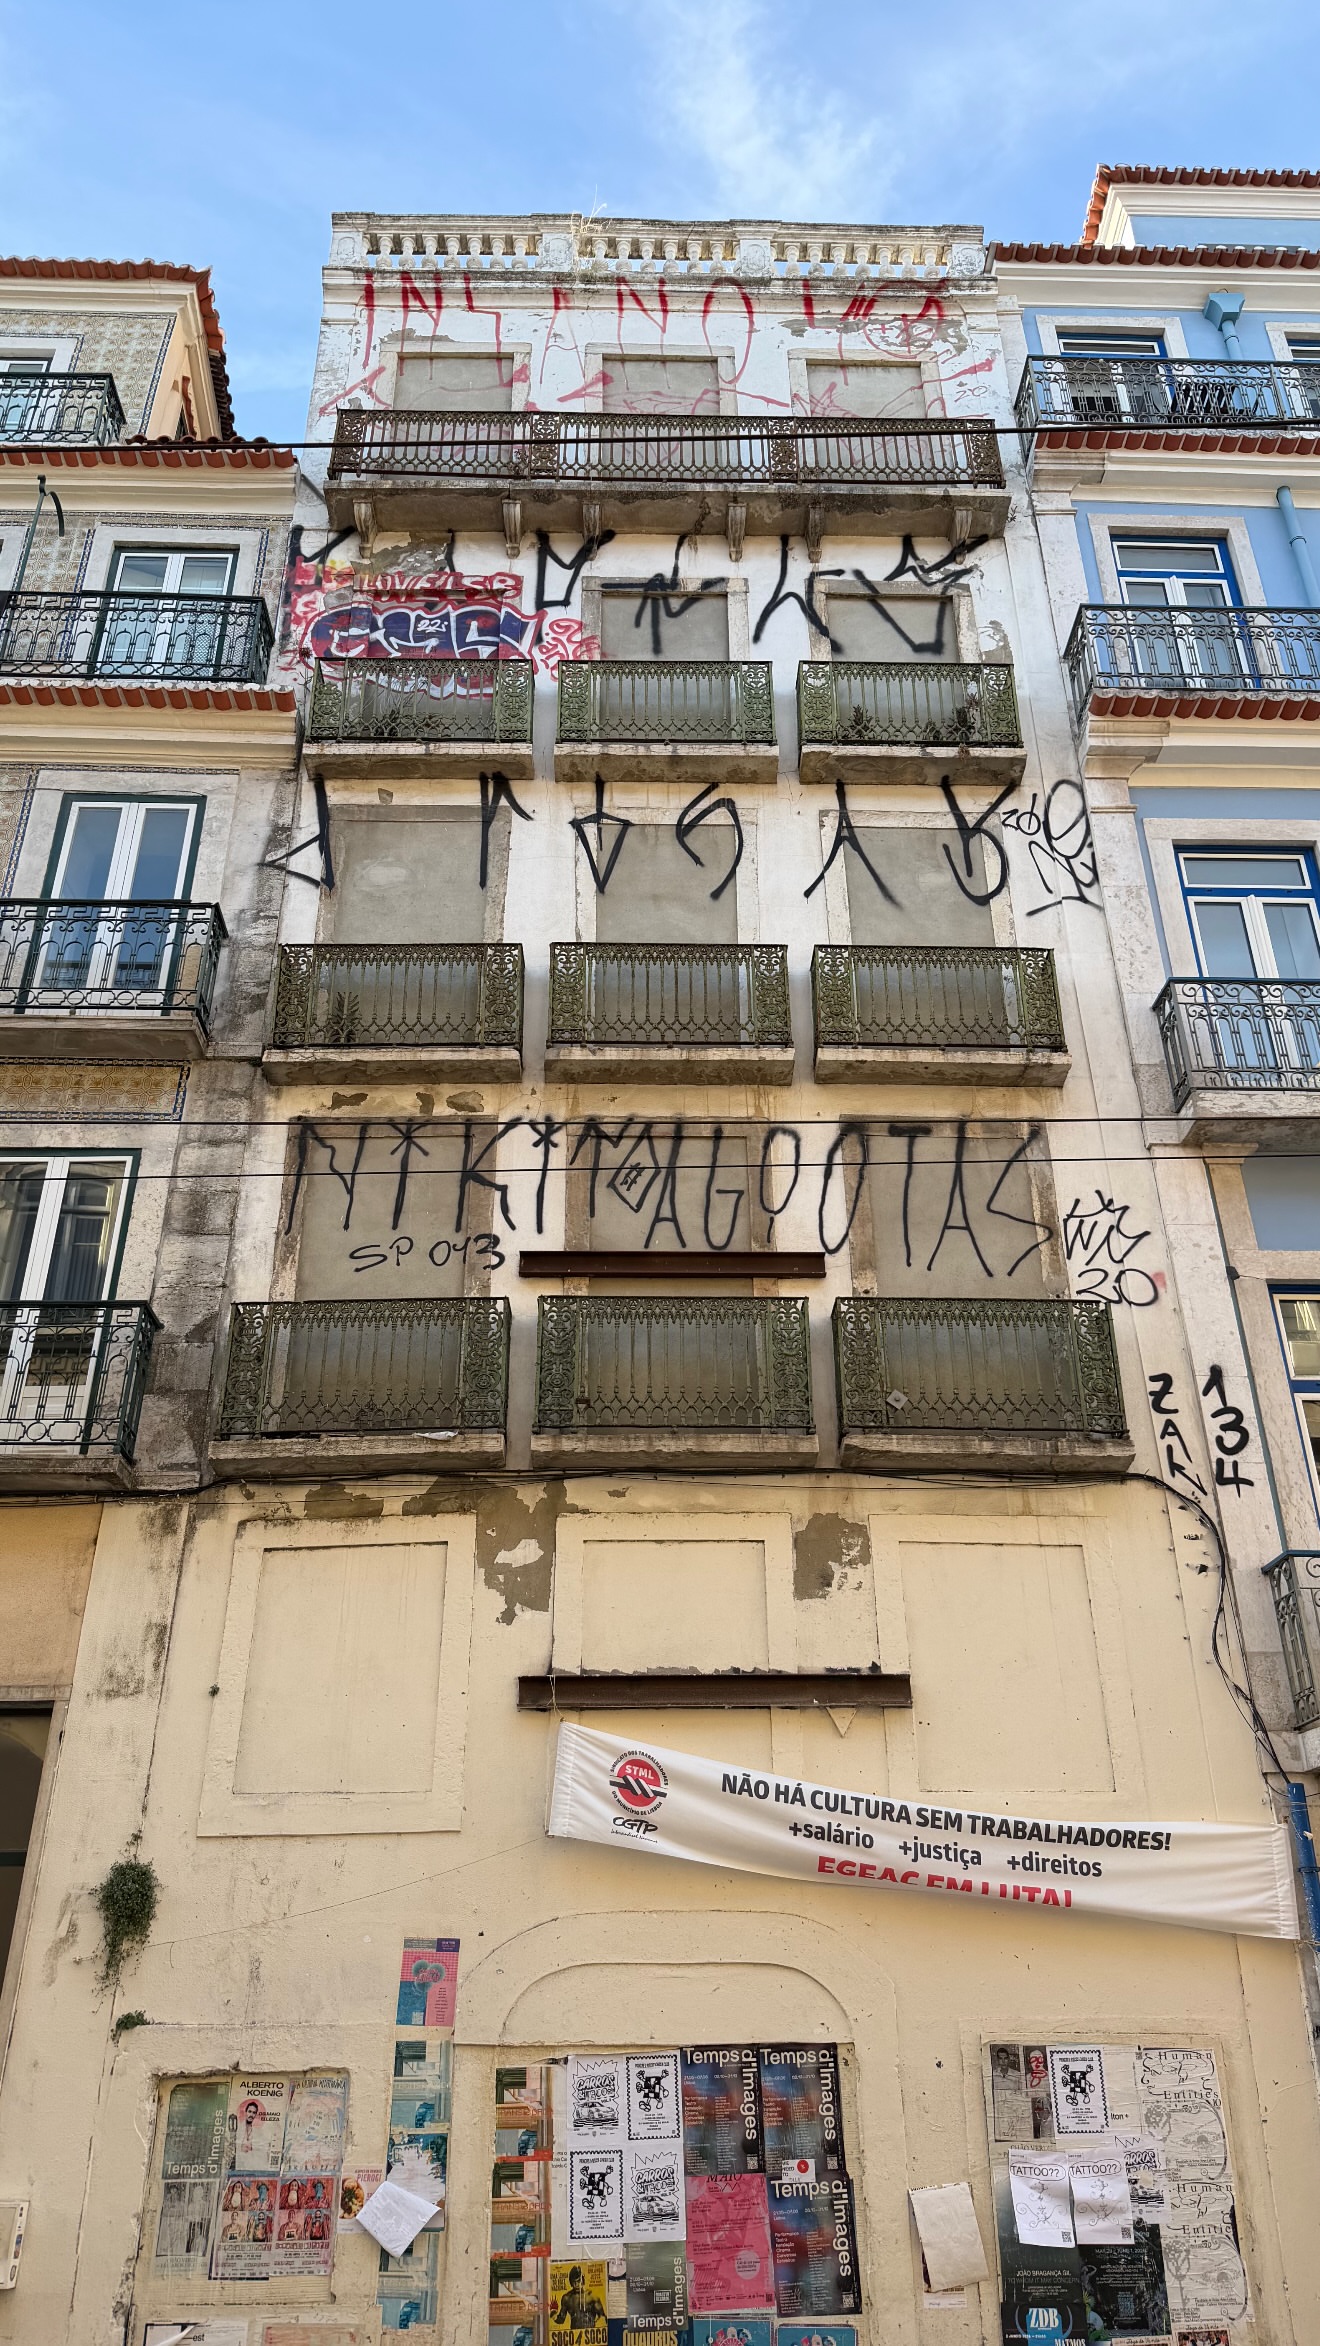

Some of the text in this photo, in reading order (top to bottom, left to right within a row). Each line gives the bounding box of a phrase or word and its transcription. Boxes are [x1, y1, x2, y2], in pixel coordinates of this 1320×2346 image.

[610, 1751, 628, 1773] SINDICATO
[625, 1765, 654, 1780] STML
[721, 1772, 1172, 1850] NÃO HÁ CULTURA SEM TRABALHADORES!
[612, 1816, 658, 1835] CGTP
[789, 1821, 1103, 1877] +salário +justiça +direitos
[683, 2047, 740, 2067] Temps
[760, 2048, 817, 2068] Temps
[1158, 2050, 1213, 2060] Human
[240, 2081, 285, 2089] ALBERTO
[576, 2074, 615, 2090] CARROS
[247, 2089, 283, 2098] KOENIG
[740, 2048, 758, 2140] d'Images
[818, 2049, 836, 2141] d'Images
[1163, 2090, 1219, 2101] Entities
[207, 2109, 224, 2174] d'Images
[1124, 2151, 1156, 2166] ARROS
[166, 2161, 206, 2177] Temps
[635, 2167, 675, 2183] CARROS
[1011, 2166, 1059, 2178] TATTOO??
[1070, 2164, 1117, 2175] TATTOO??
[771, 2180, 830, 2200] Temps
[1176, 2184, 1233, 2193] Human
[831, 2180, 851, 2277] d'Images
[672, 2257, 686, 2326] d'Images
[629, 2314, 672, 2331] Temps
[1029, 2307, 1060, 2328] ZDB
[551, 2330, 575, 2346] SOCO
[584, 2328, 608, 2344] SOCO
